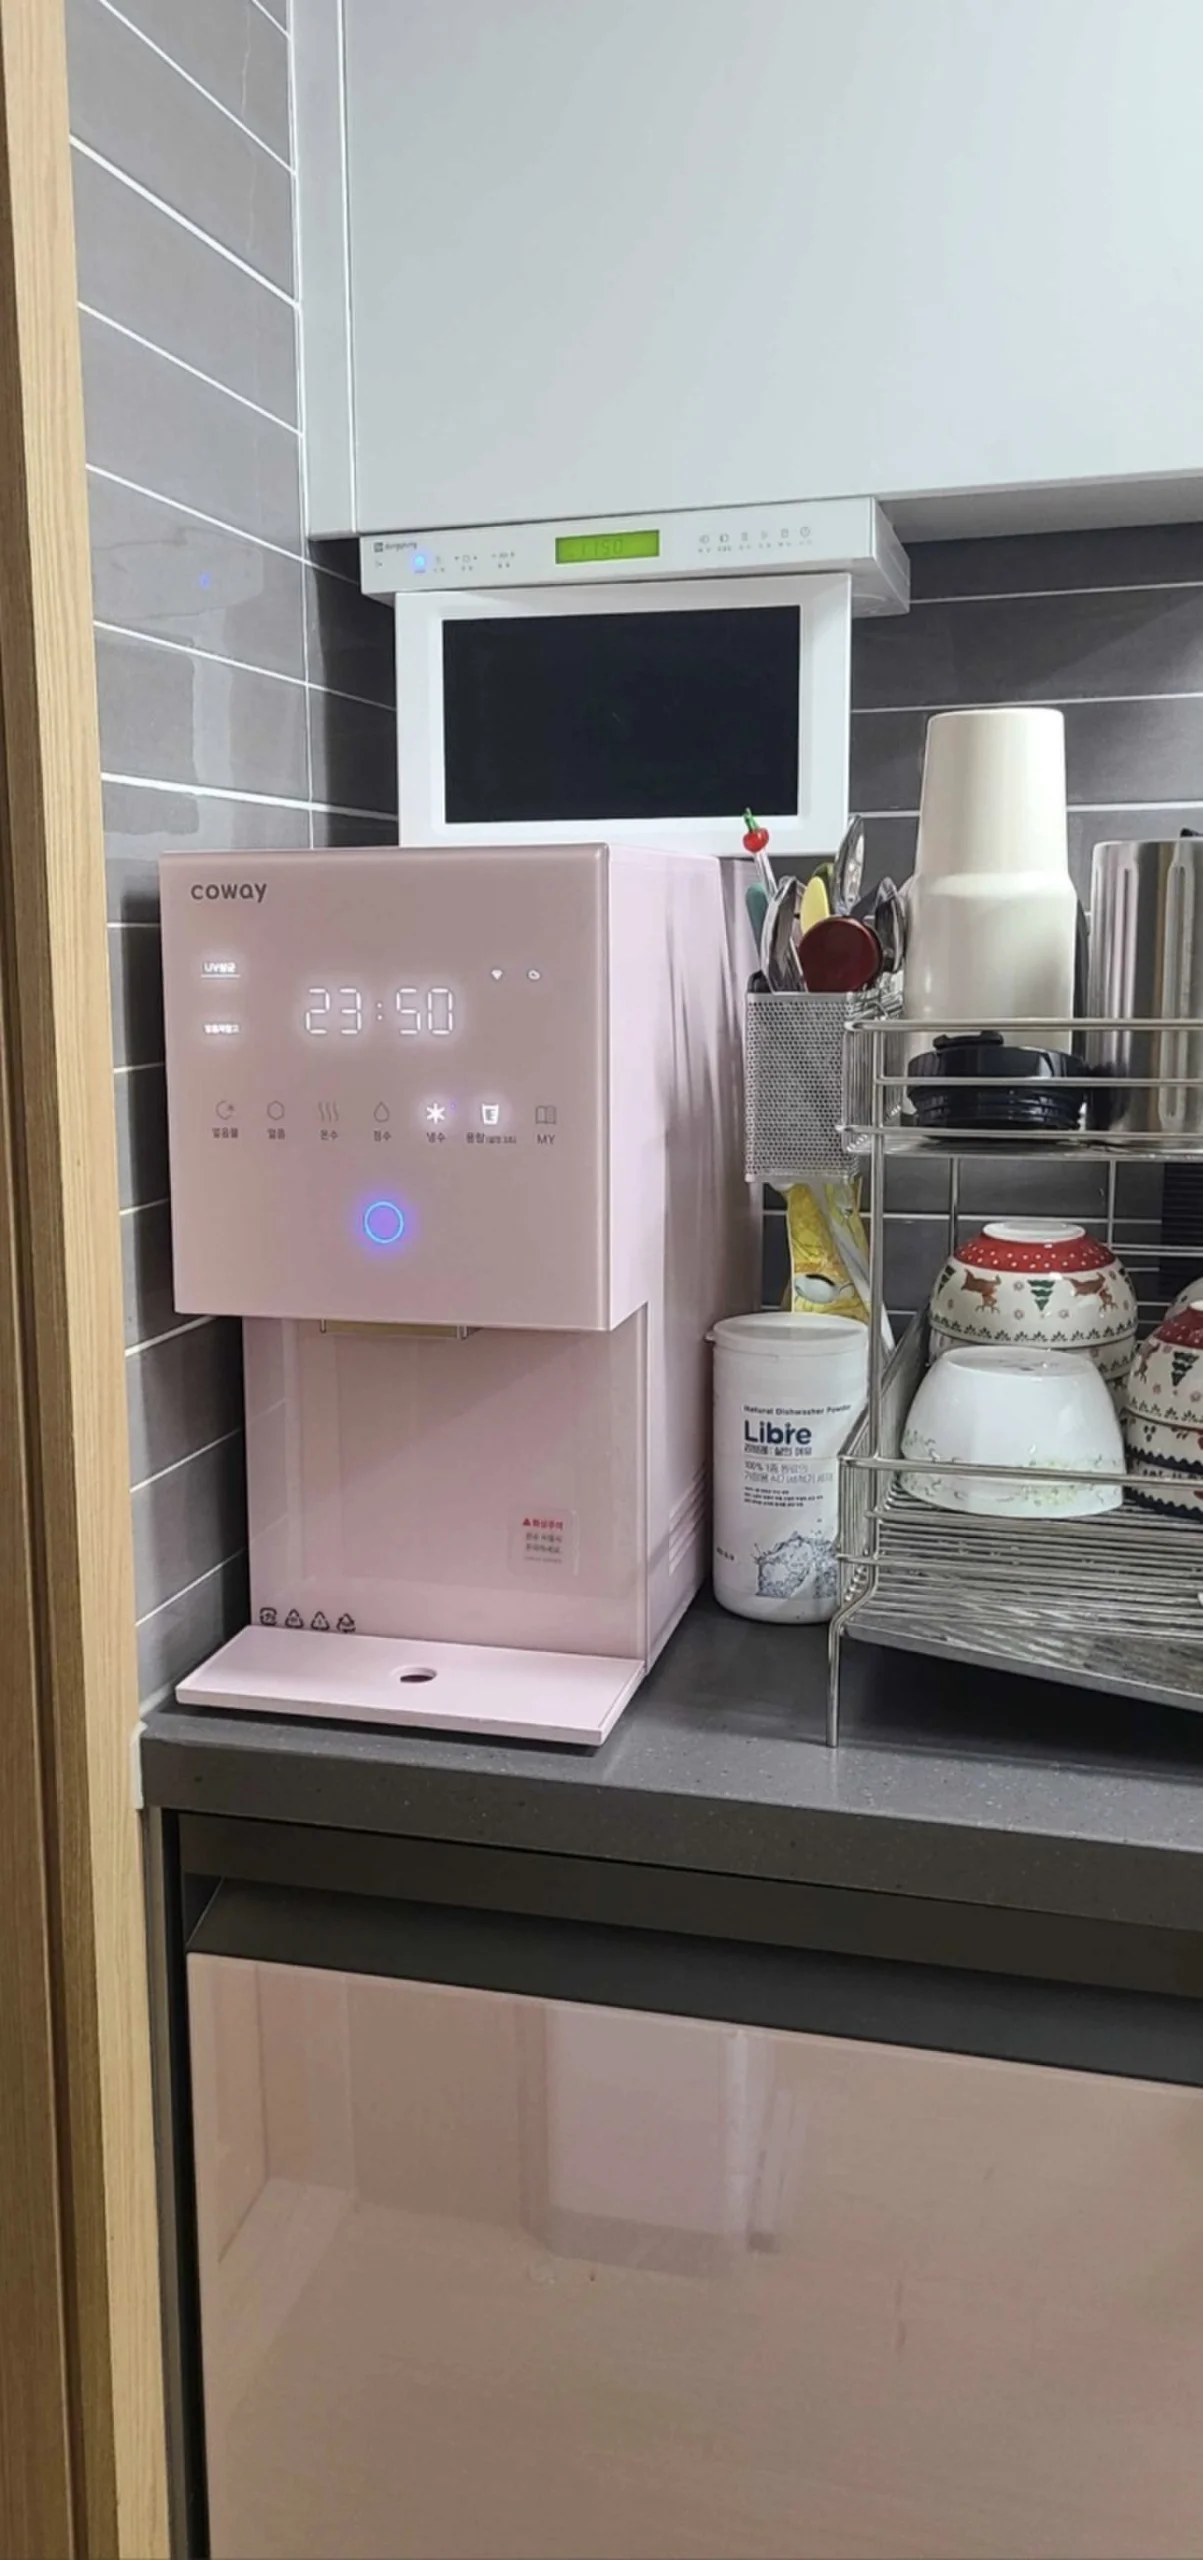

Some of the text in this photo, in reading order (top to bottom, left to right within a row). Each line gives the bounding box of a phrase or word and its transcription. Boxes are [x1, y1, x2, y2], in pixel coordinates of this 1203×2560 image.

[190, 883, 267, 904] coway
[305, 988, 453, 1035] 23:50
[320, 1129, 339, 1141] 온수
[373, 1130, 391, 1142] 정수
[426, 1132, 446, 1144] 냉수
[537, 1134, 556, 1145] MY
[775, 1407, 825, 1416] Dishwasher
[744, 1419, 812, 1446] Libre
